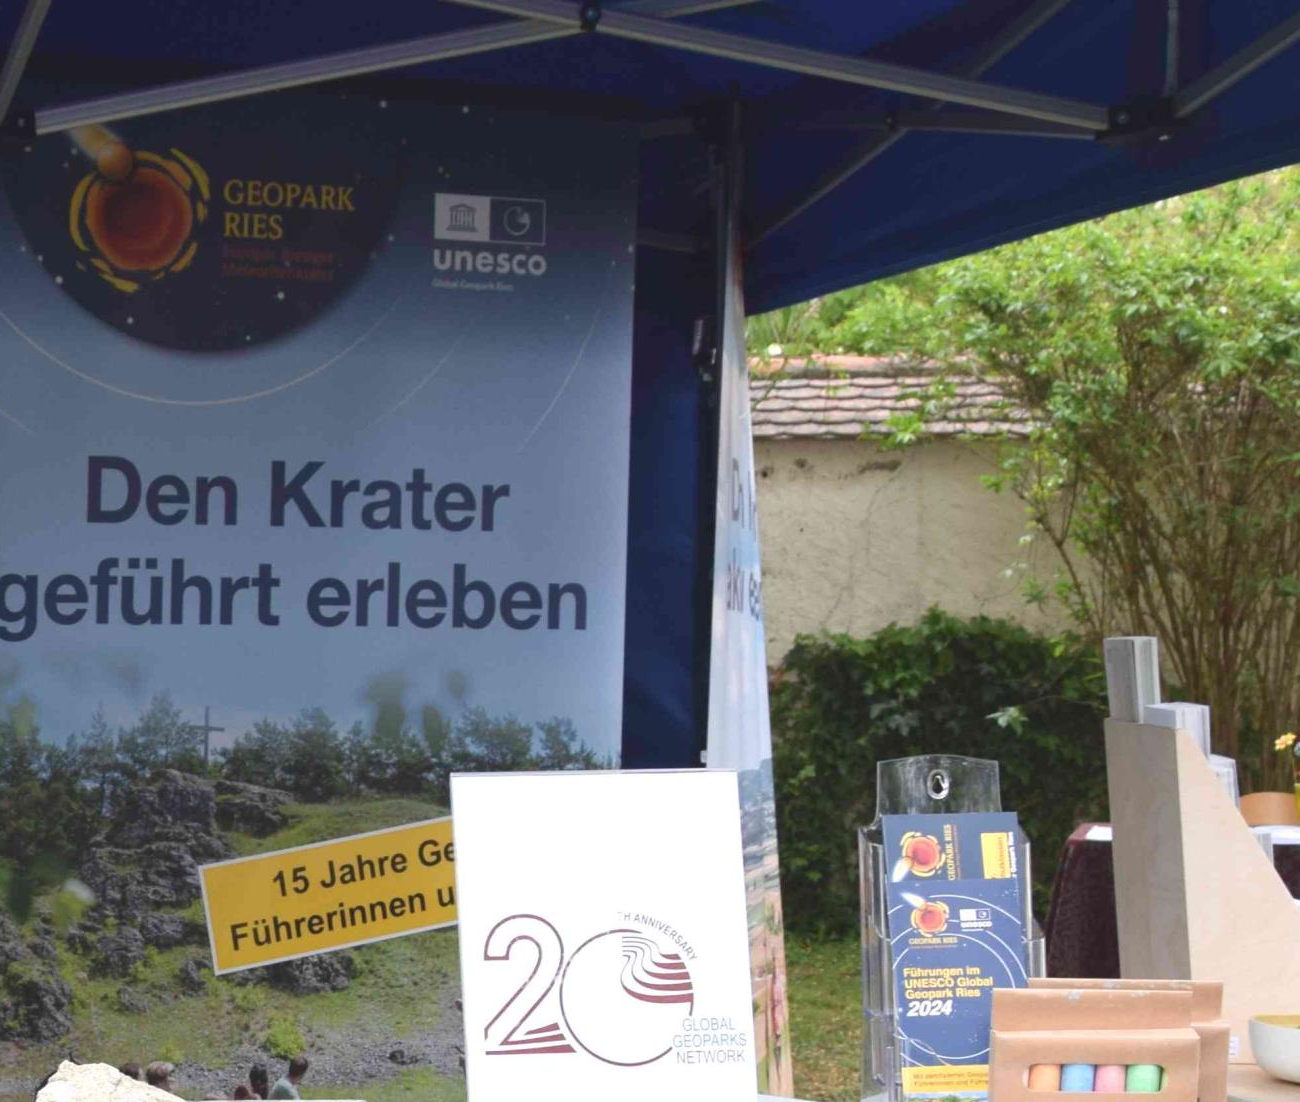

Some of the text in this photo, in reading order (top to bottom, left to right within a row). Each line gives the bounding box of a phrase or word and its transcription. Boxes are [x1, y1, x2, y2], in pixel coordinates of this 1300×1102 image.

[222, 179, 355, 212] GEOPARK
[222, 213, 283, 240] RIES
[432, 248, 547, 276] unesco
[86, 455, 510, 532] Den Krater
[306, 561, 589, 630] erleben
[272, 838, 457, 898] 15 Jahre Ge
[230, 886, 457, 952] Führerinnen u
[960, 920, 993, 928] unesco
[632, 913, 699, 962] ANNIVERSARY
[908, 936, 958, 945] GEOPARK RIES
[903, 965, 981, 979] Führungen im
[904, 976, 994, 989] UNESCO Global
[905, 987, 981, 1000] Geopark Ries
[906, 1000, 953, 1017] 2024
[682, 1017, 737, 1032] GLOBAL
[672, 1032, 747, 1048] GEOPARKS
[676, 1049, 746, 1064] NETWORK
